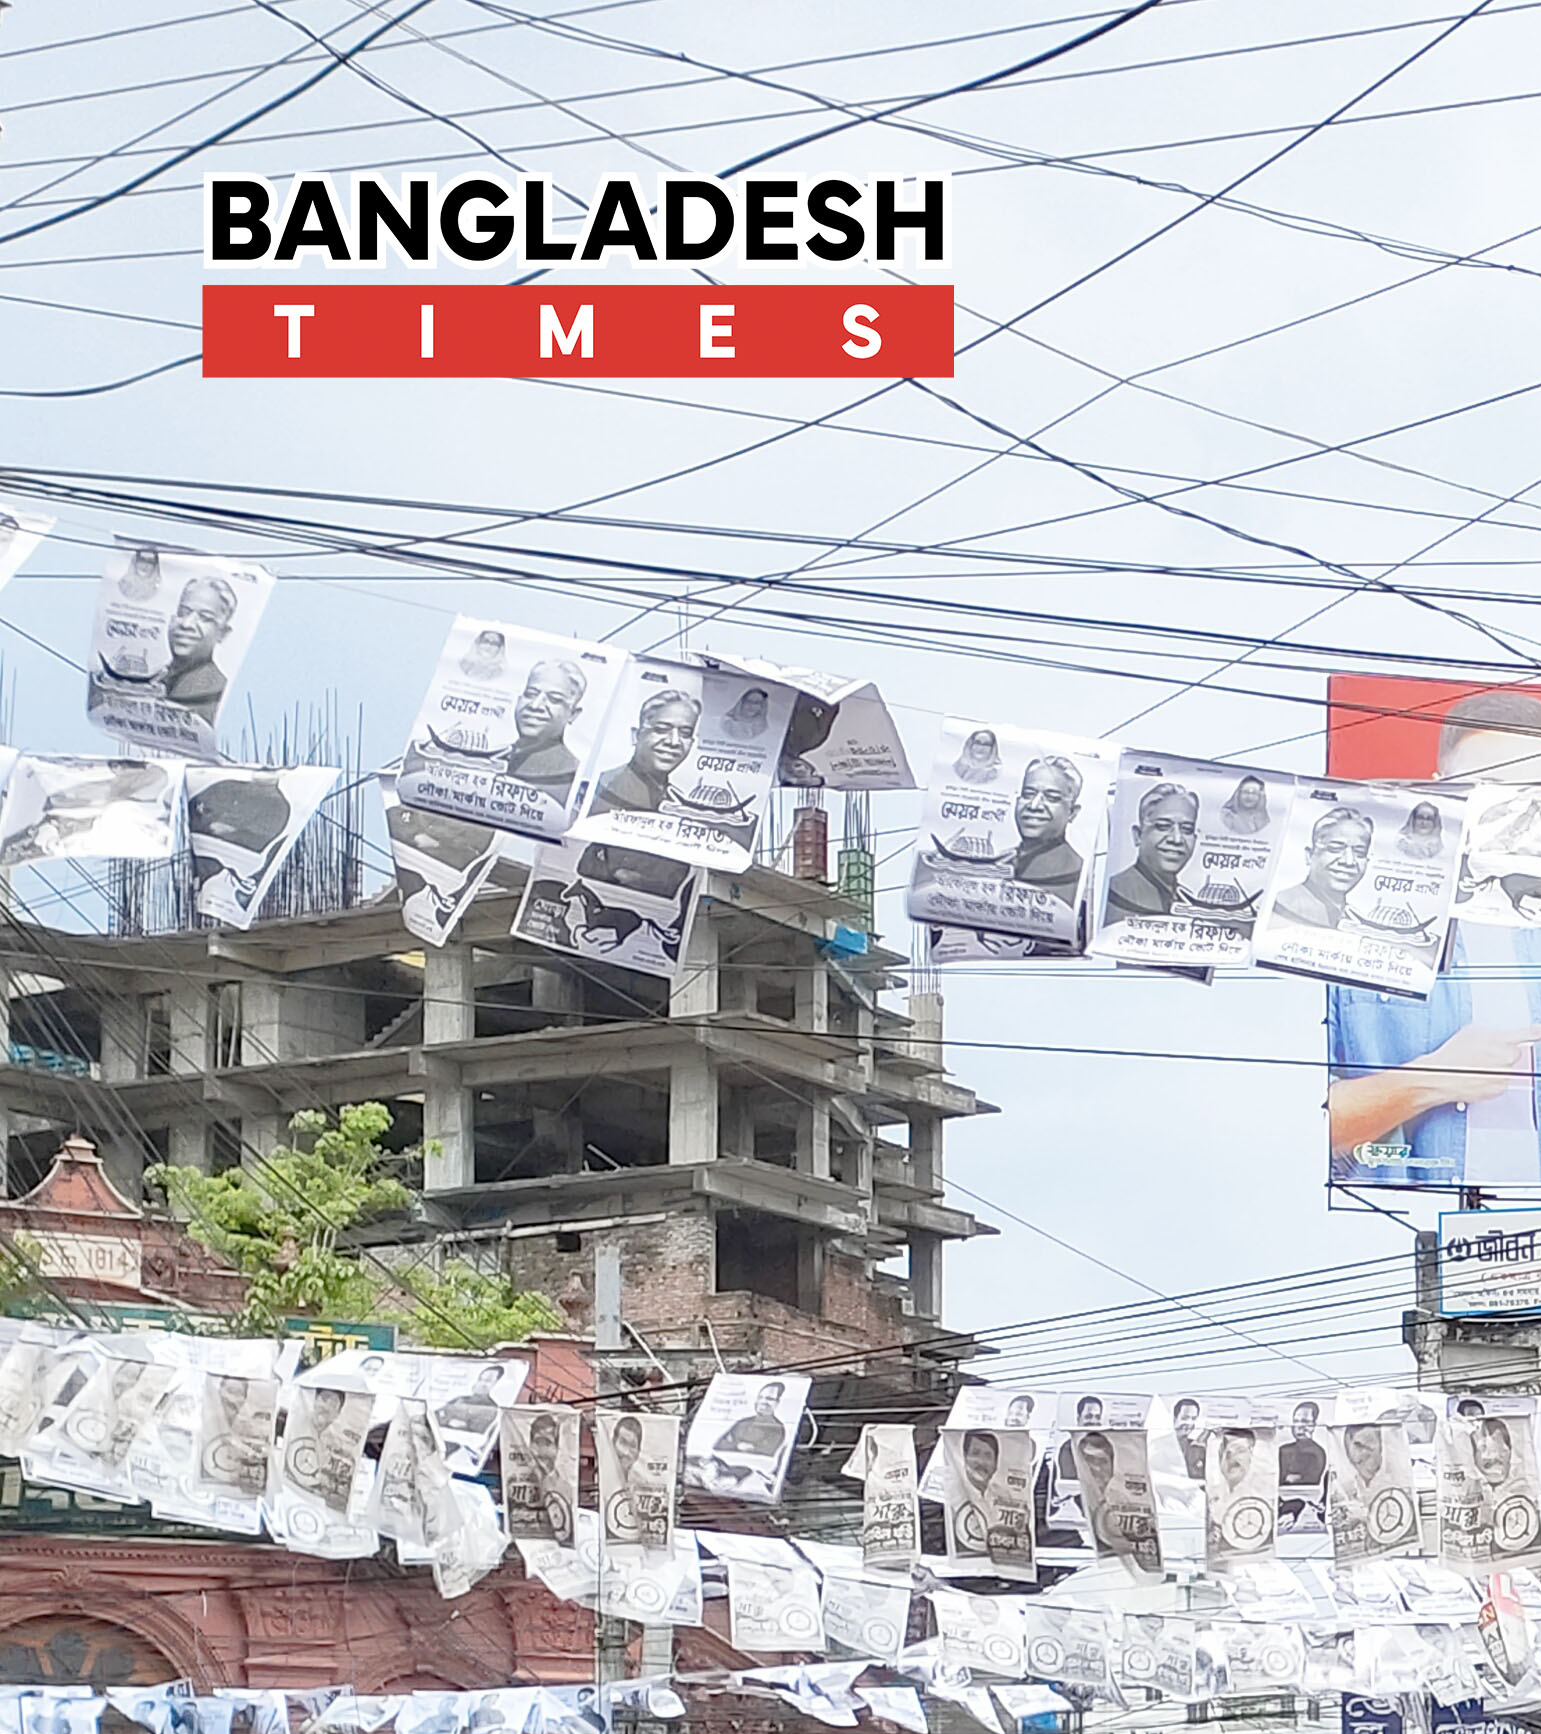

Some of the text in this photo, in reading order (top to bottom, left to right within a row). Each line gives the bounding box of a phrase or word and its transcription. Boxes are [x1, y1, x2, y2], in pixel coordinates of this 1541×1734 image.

[441, 694, 478, 716] মেয়র
[696, 754, 734, 773] মেয়র
[490, 774, 540, 803] রিফাত
[942, 801, 979, 820] মেয়র
[675, 818, 725, 842] রিফাত
[1202, 852, 1241, 870] মেয়র
[1374, 874, 1412, 892] মেয়র
[1190, 919, 1238, 943] রিফাত
[1475, 1229, 1535, 1262] জীবন
